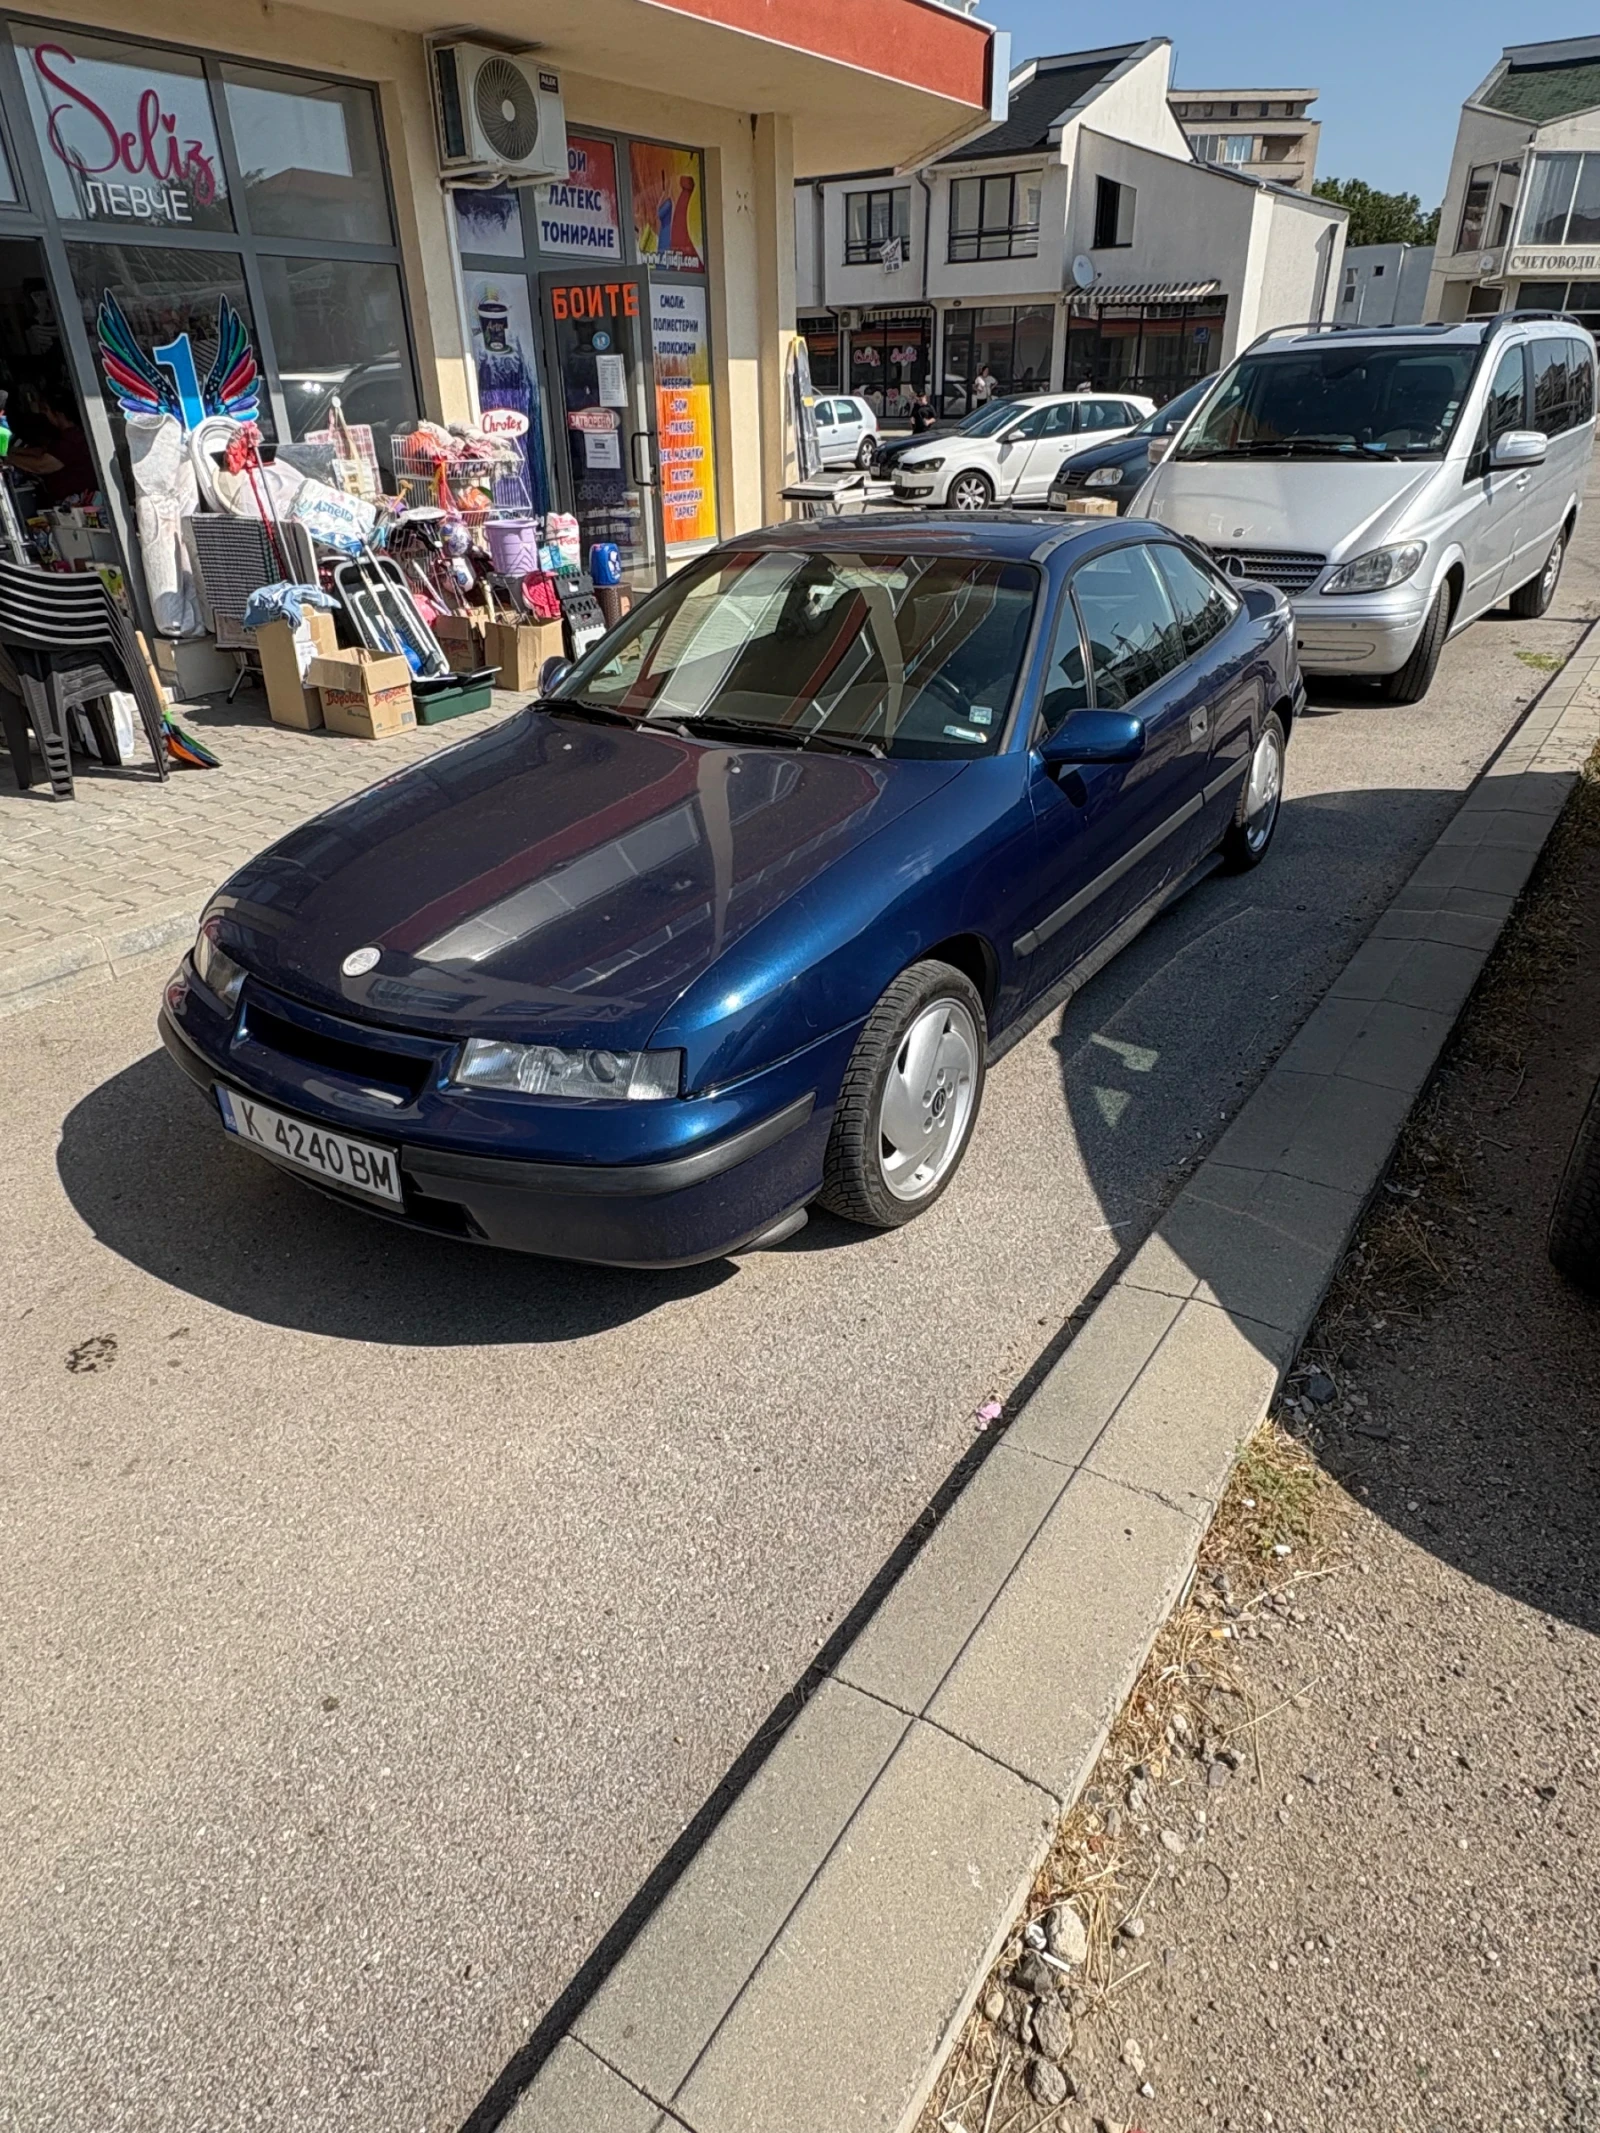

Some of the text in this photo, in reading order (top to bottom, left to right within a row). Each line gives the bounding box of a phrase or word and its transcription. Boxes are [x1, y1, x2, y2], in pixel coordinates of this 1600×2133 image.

[34, 43, 215, 204] Seliz
[567, 149, 586, 173] ОИ
[87, 181, 192, 221] ЛЕВЧЕ
[549, 184, 602, 212] ЛАТЕКС
[541, 220, 615, 248] ТОНИРАНЕ
[1511, 255, 1600, 271] СЧЕТОВОДН
[552, 283, 640, 320] БОИТЕ
[482, 414, 522, 434] Chrotex
[241, 1101, 264, 1142] K
[275, 1118, 344, 1175] 4240
[347, 1144, 394, 1195] BM
